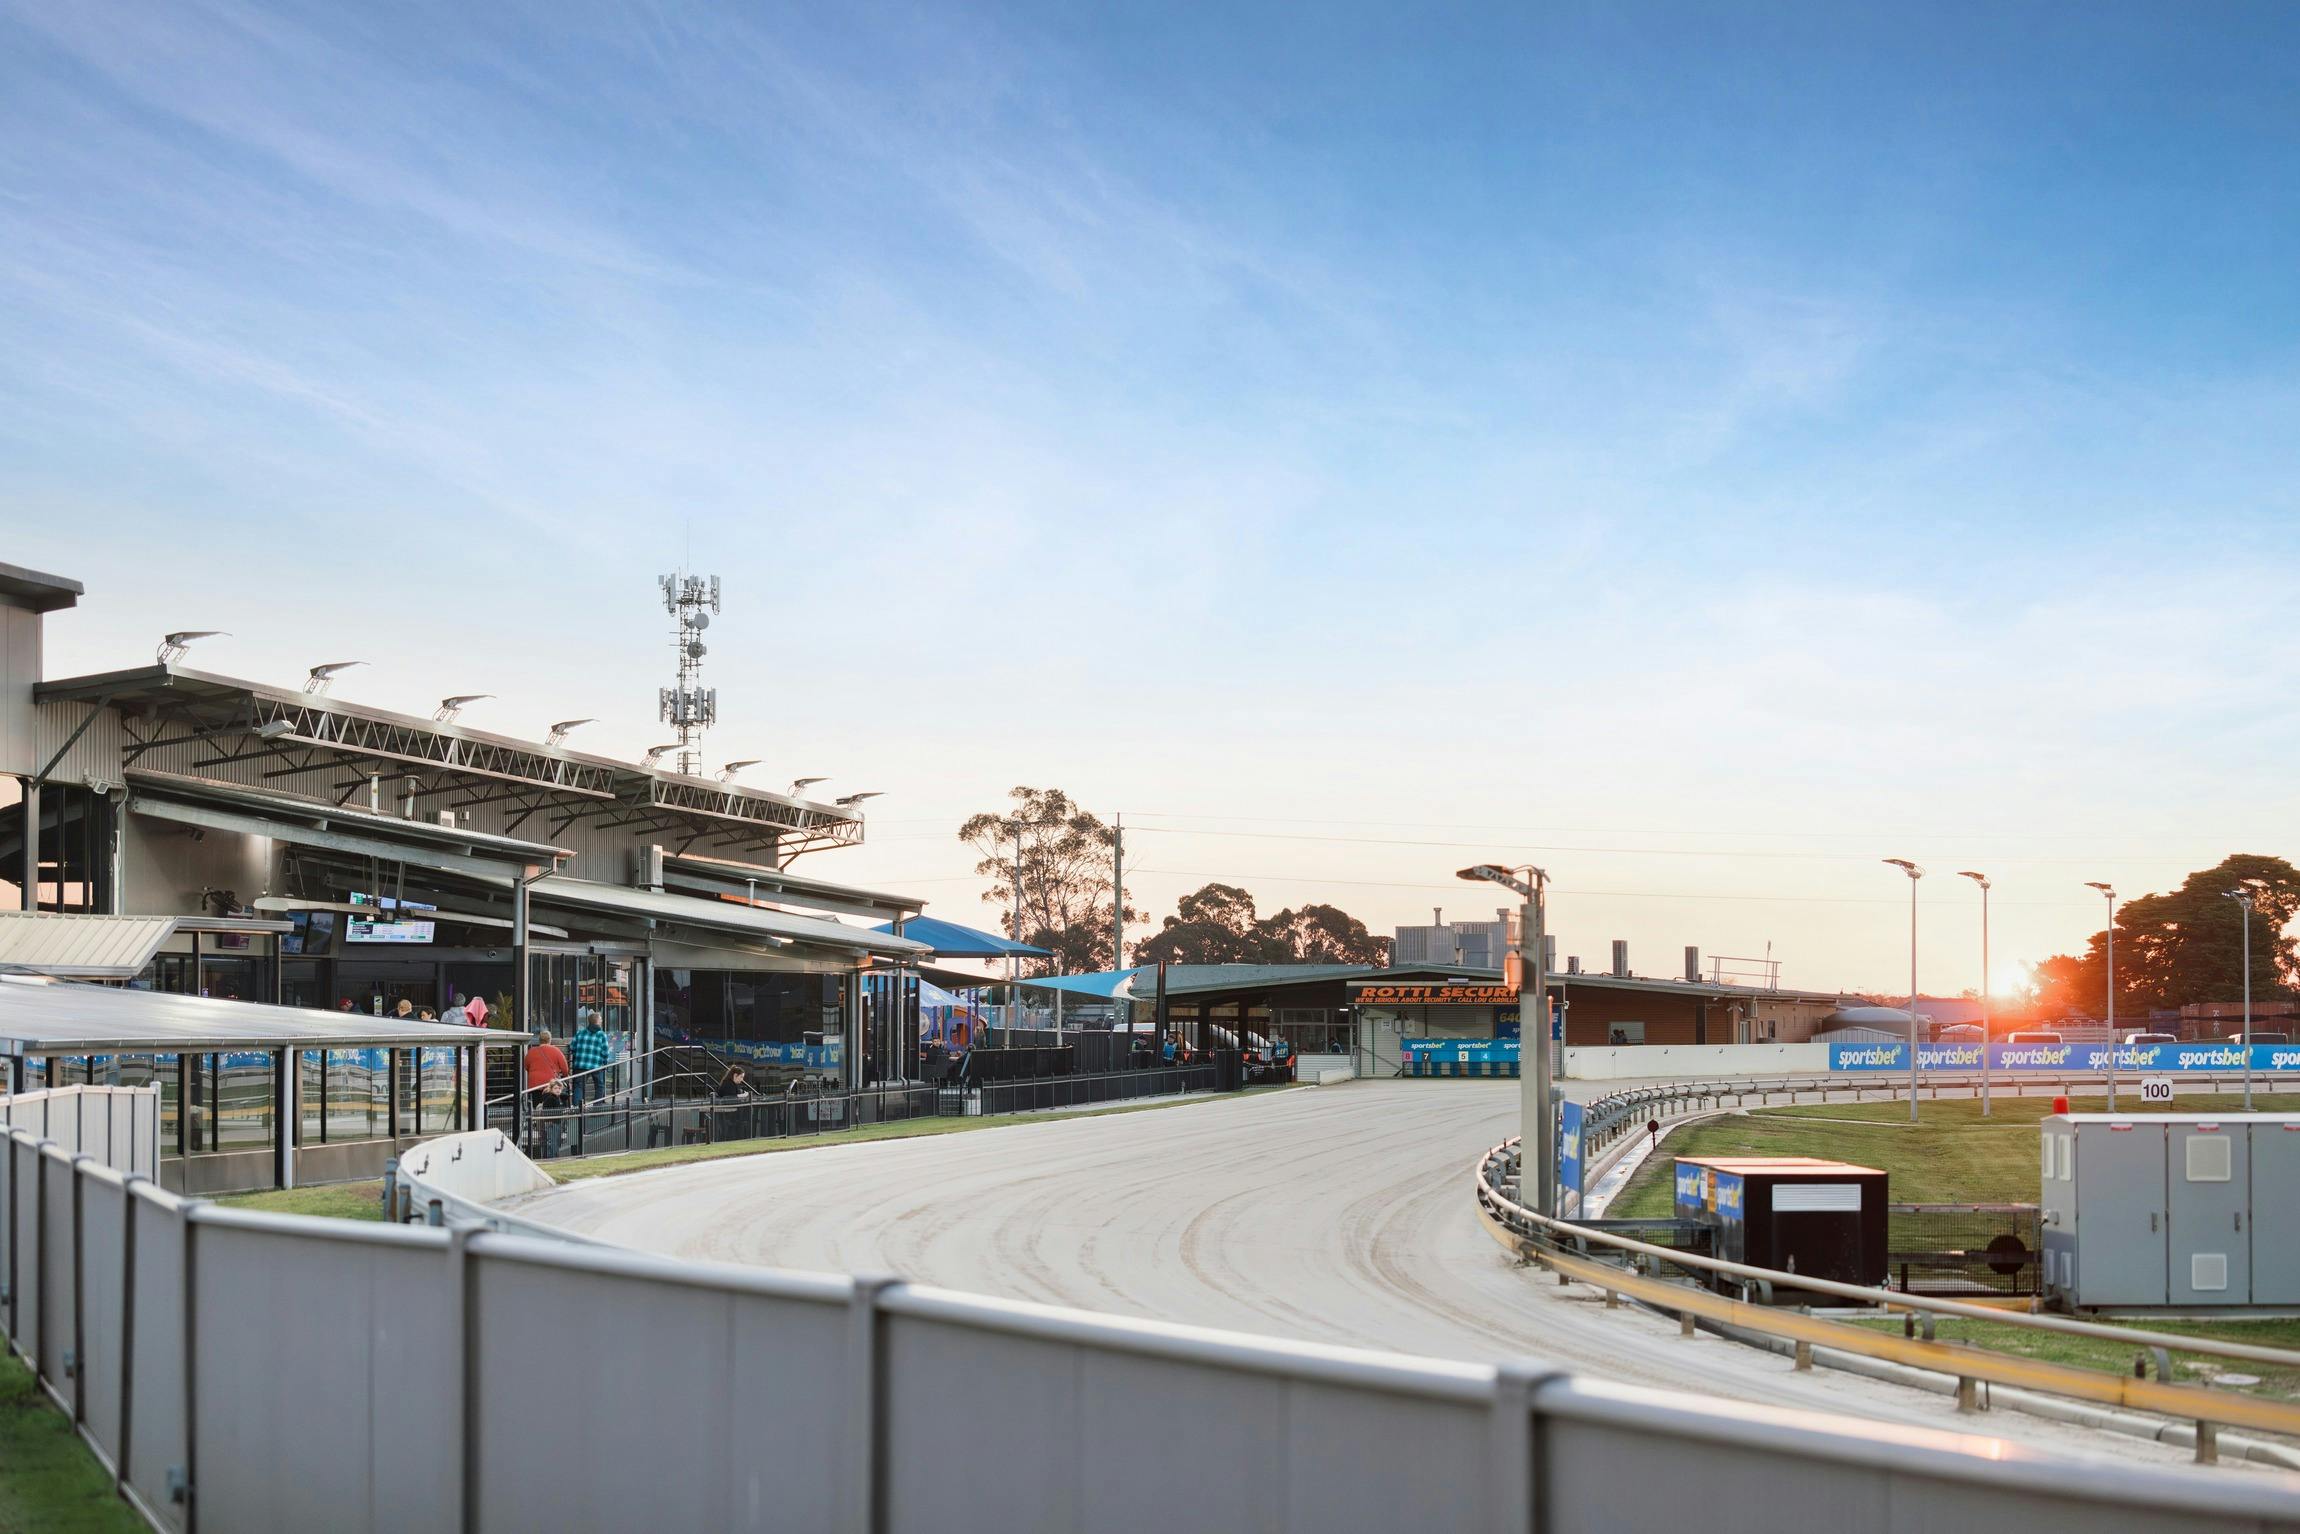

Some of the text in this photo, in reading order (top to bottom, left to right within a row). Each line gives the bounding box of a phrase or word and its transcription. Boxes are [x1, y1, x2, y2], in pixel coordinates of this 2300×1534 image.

[1361, 986, 1519, 997] ROTTI SECURI
[1411, 1042, 1443, 1050] sportsbet
[1457, 1042, 1489, 1050] sportsbet
[1839, 1046, 1897, 1069] sportsbet
[1917, 1046, 1978, 1069] sportsbet
[2001, 1046, 2065, 1069] sportsbet
[2271, 1052, 2300, 1070] spor
[2143, 1084, 2170, 1098] 100
